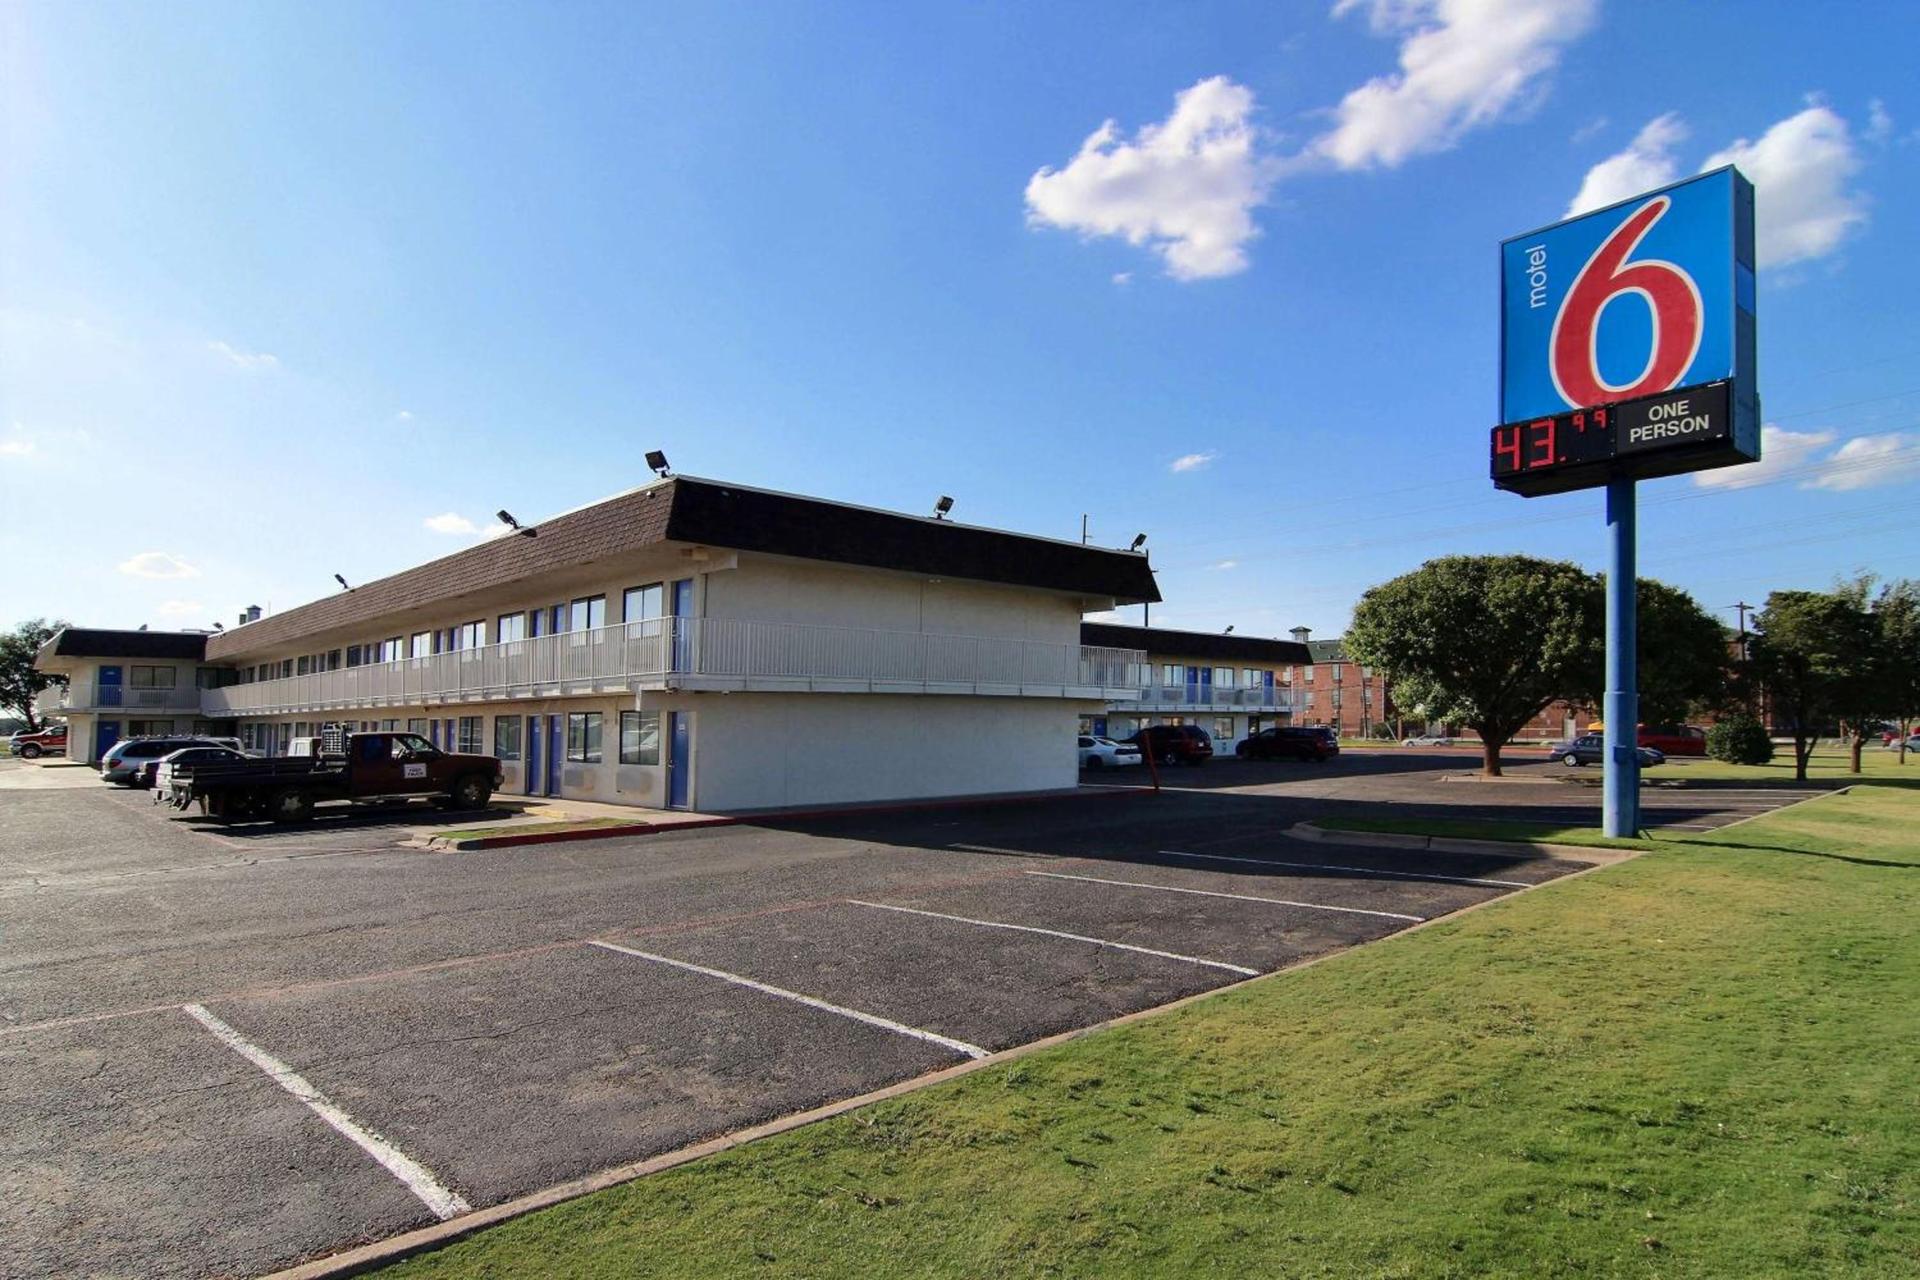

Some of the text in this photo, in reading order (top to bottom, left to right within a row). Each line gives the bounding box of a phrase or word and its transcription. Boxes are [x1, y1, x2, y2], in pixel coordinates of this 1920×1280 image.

[1525, 243, 1547, 308] motel
[1549, 195, 1704, 410] 6
[1629, 414, 1710, 443] PERSON
[1648, 400, 1690, 420] ONE
